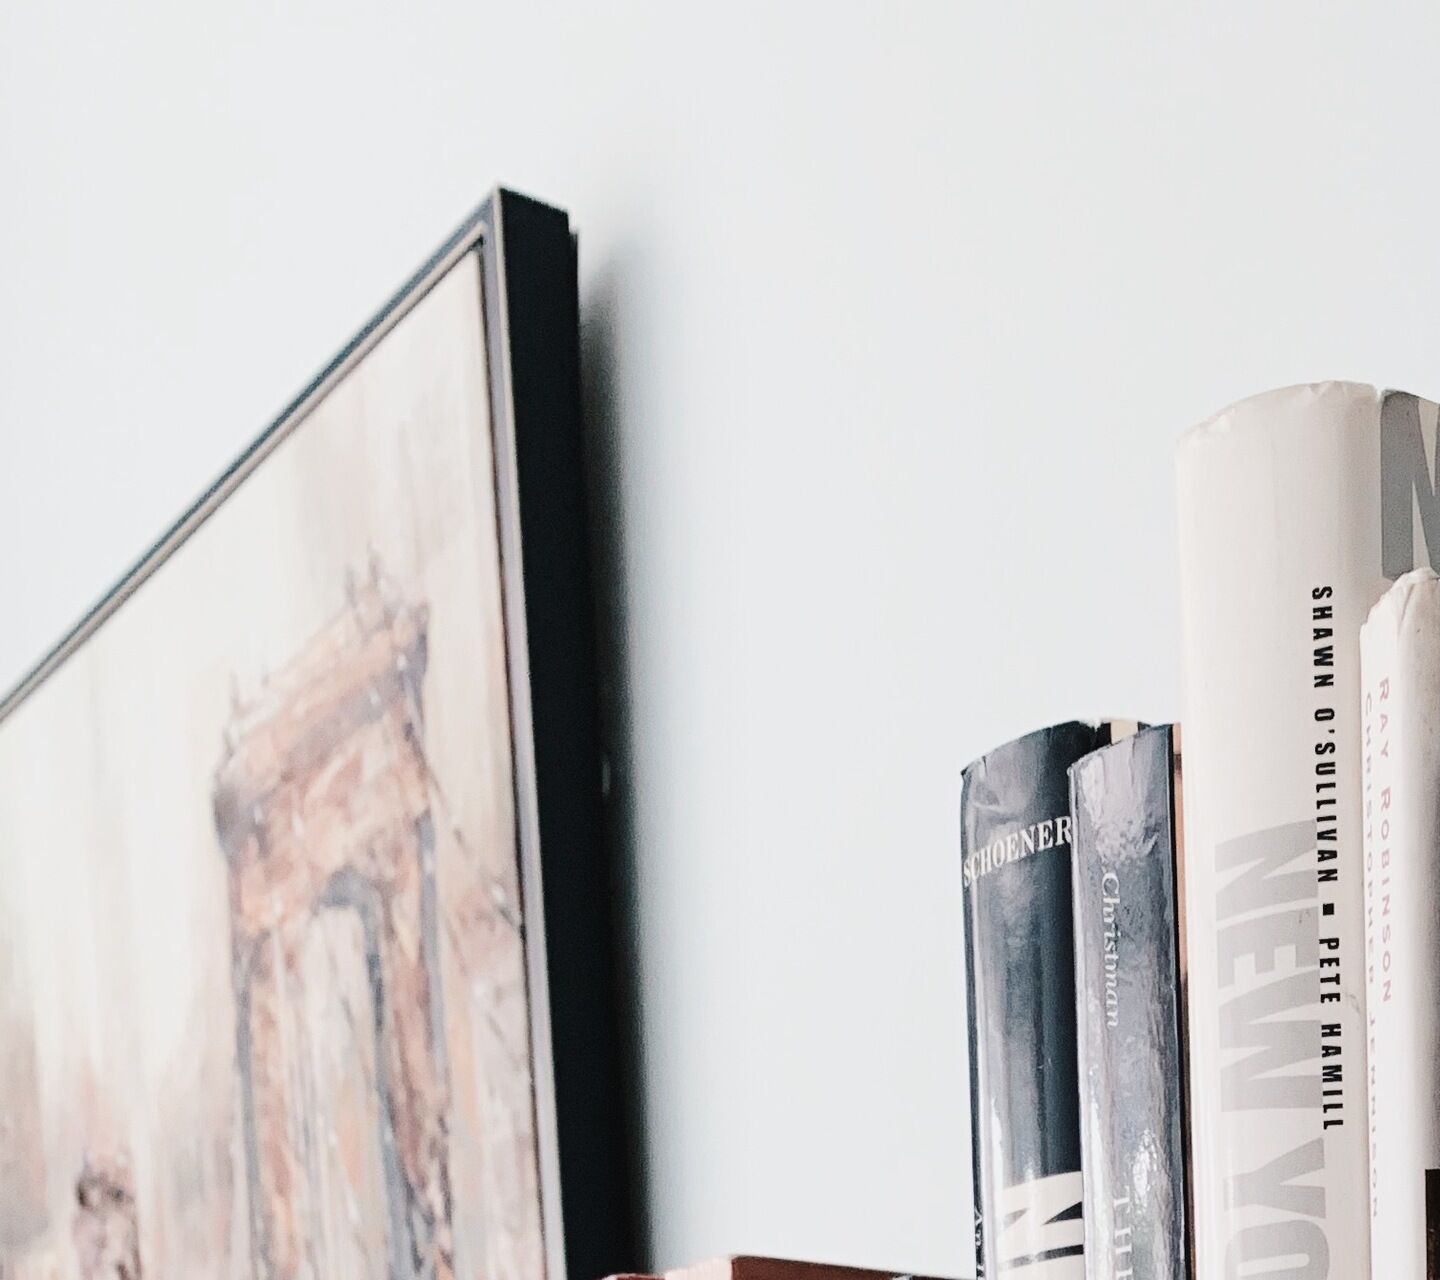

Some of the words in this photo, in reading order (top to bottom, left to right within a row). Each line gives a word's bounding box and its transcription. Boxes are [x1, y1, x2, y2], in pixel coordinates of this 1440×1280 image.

[1311, 585, 1335, 689] SHAWN
[1378, 676, 1390, 759] RAY
[963, 816, 1073, 888] SCHOENER
[1314, 707, 1339, 883] O'SULLIVAN
[1365, 691, 1374, 984] CHRISTOPHER
[1101, 871, 1121, 1028] Christman
[1379, 786, 1392, 1003] ROBINSON
[1214, 819, 1324, 1112] NEW
[1318, 936, 1342, 1005] PETE
[1320, 1022, 1344, 1131] HAMILL
